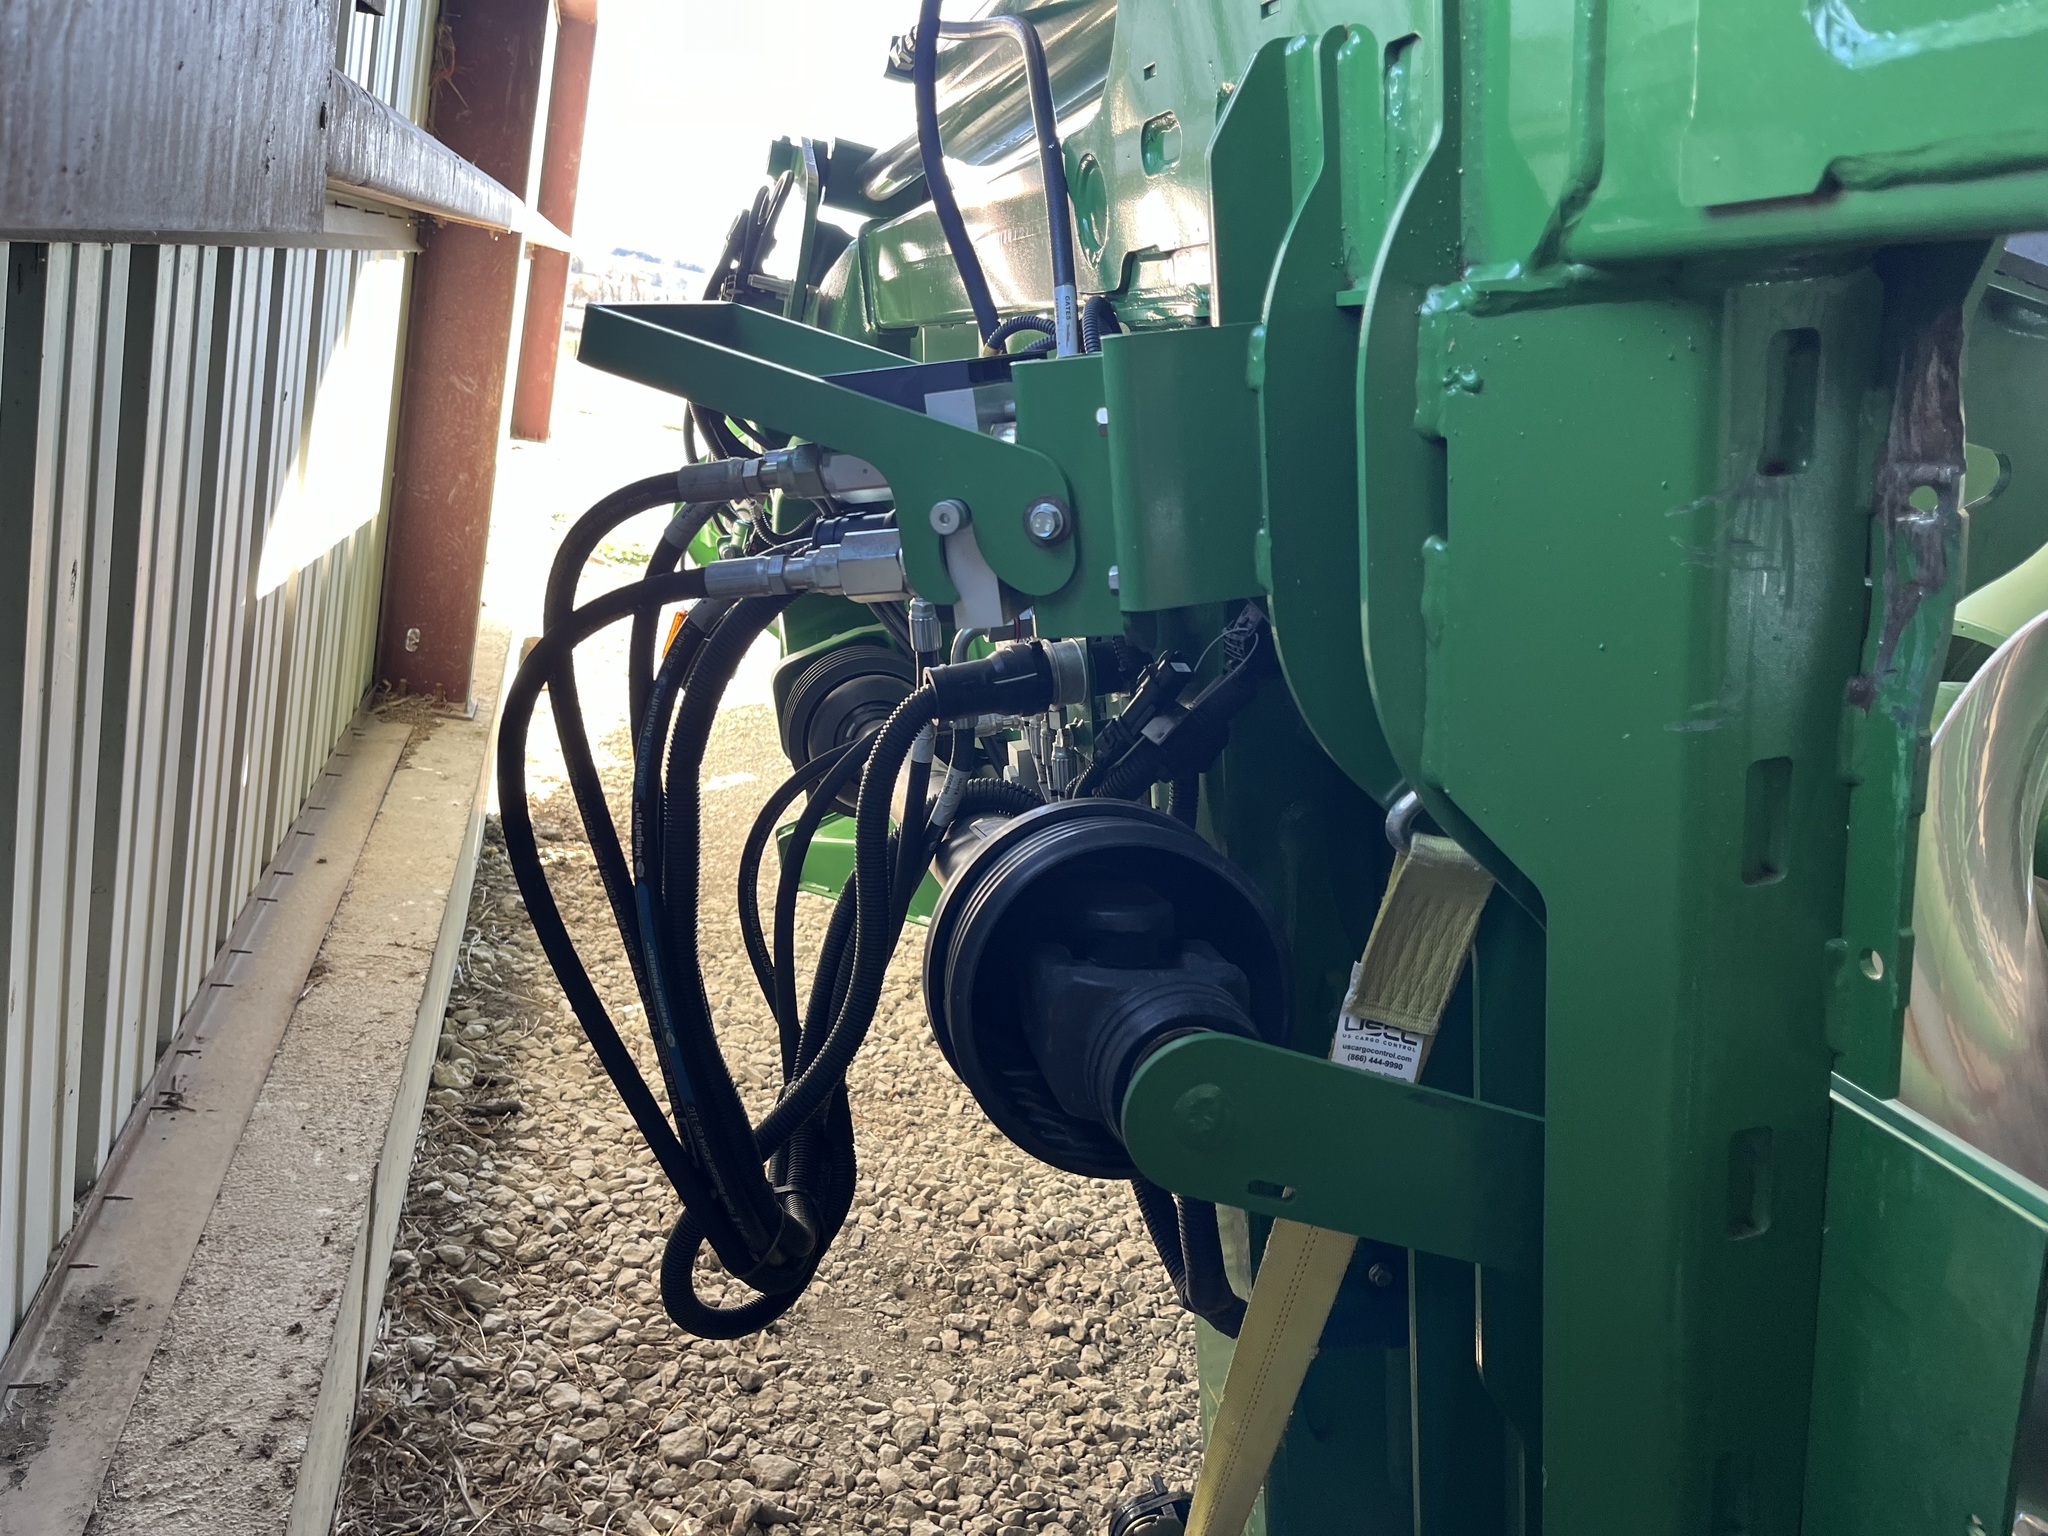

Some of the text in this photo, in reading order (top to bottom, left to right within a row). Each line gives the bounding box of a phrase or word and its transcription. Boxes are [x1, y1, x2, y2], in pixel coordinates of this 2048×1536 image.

[1064, 295, 1072, 320] GATES
[664, 628, 690, 669] 22.5 MPa
[615, 903, 627, 930] MPa
[1342, 1044, 1412, 1063] uscargocontrol.com
[1355, 1035, 1380, 1043] CARGO
[1383, 1040, 1416, 1052] CONTROL
[1347, 1053, 1403, 1070] (866) 444-9990
[687, 1106, 705, 1136] 2G-11C
[697, 1137, 711, 1161] MSHA
